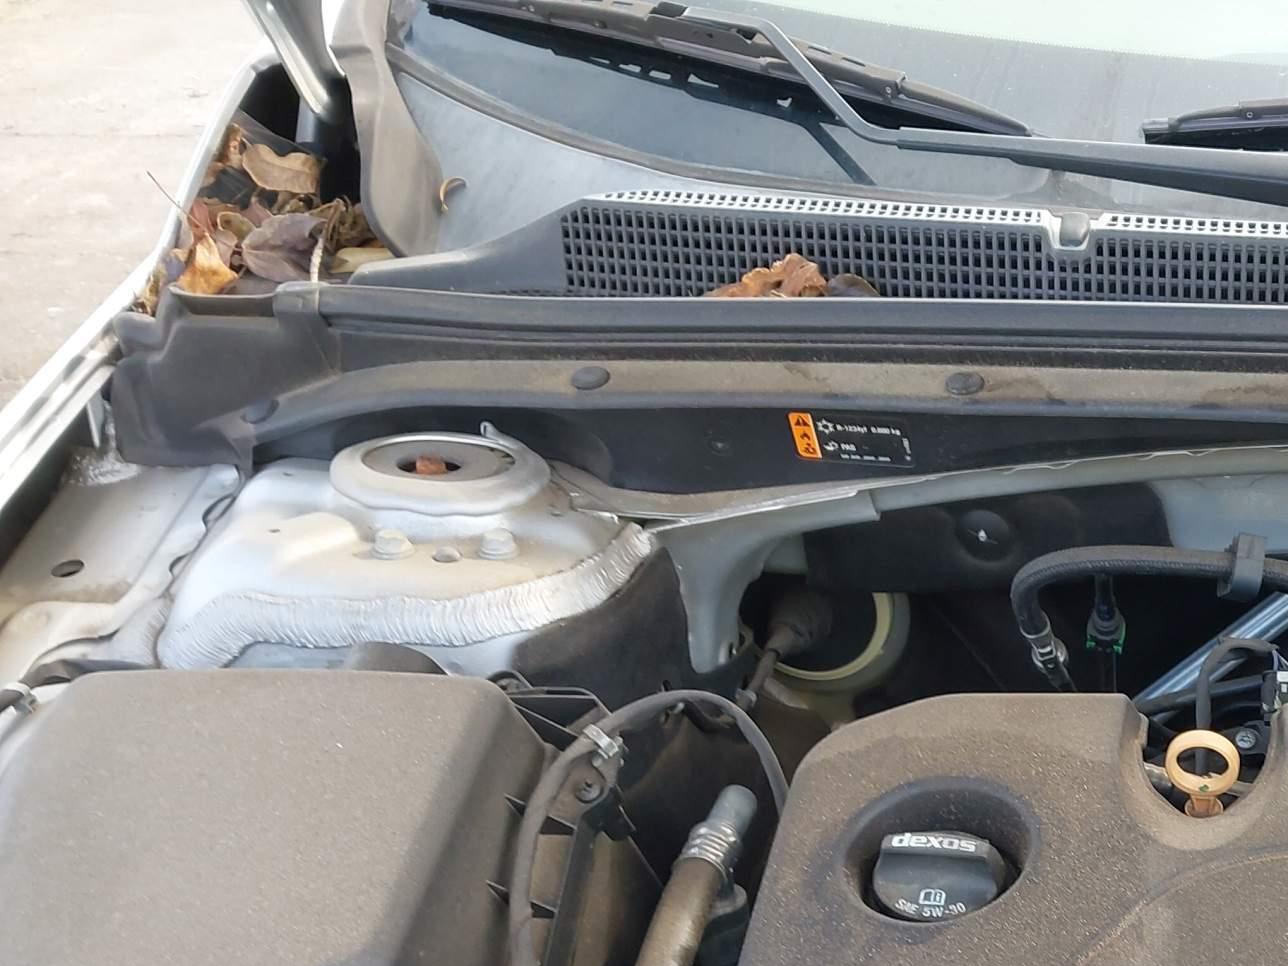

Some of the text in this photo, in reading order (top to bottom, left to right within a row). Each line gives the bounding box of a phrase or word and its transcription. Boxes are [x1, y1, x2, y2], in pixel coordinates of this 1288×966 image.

[892, 832, 976, 852] dexos
[895, 899, 966, 917] SAE 5W-30
